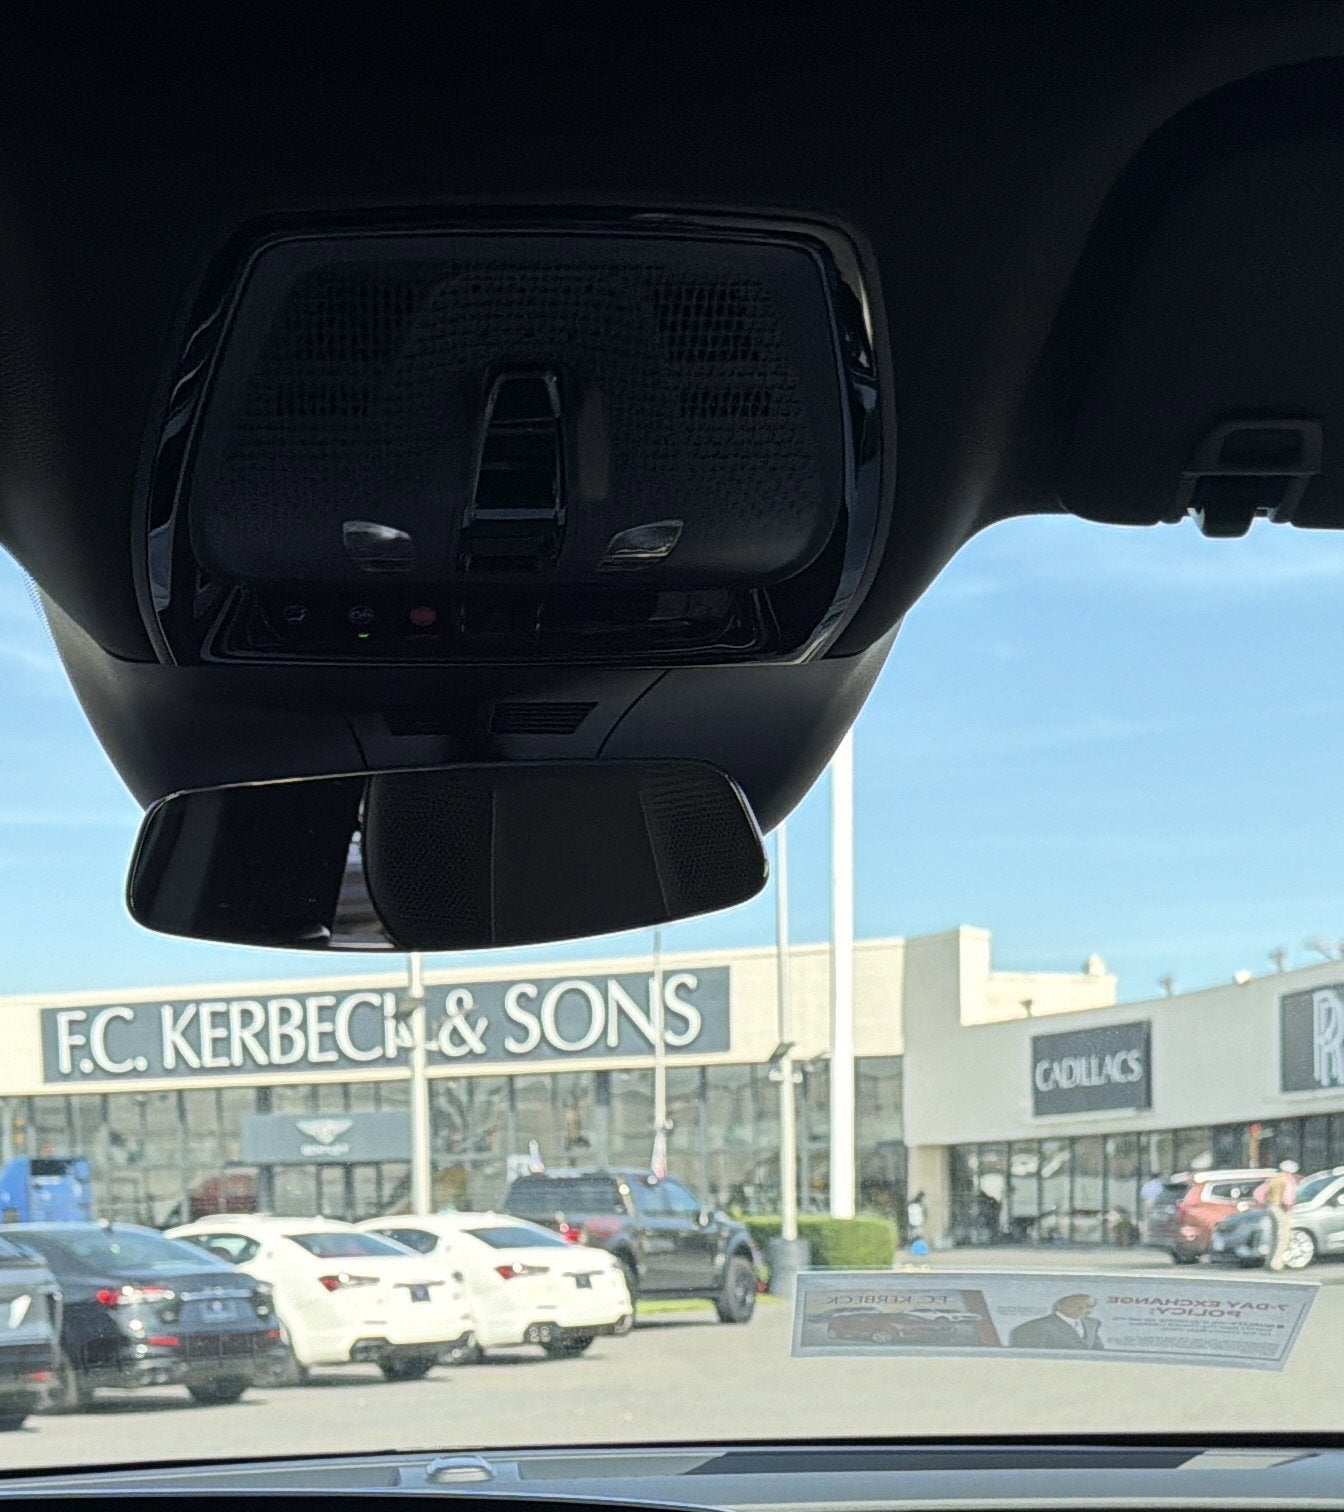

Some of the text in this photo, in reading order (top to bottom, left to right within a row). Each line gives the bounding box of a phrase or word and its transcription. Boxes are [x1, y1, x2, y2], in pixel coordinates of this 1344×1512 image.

[55, 1006, 148, 1073] F.C.
[438, 988, 488, 1056] &
[504, 973, 701, 1055] SONS
[1035, 1049, 1144, 1092] CADILLACS
